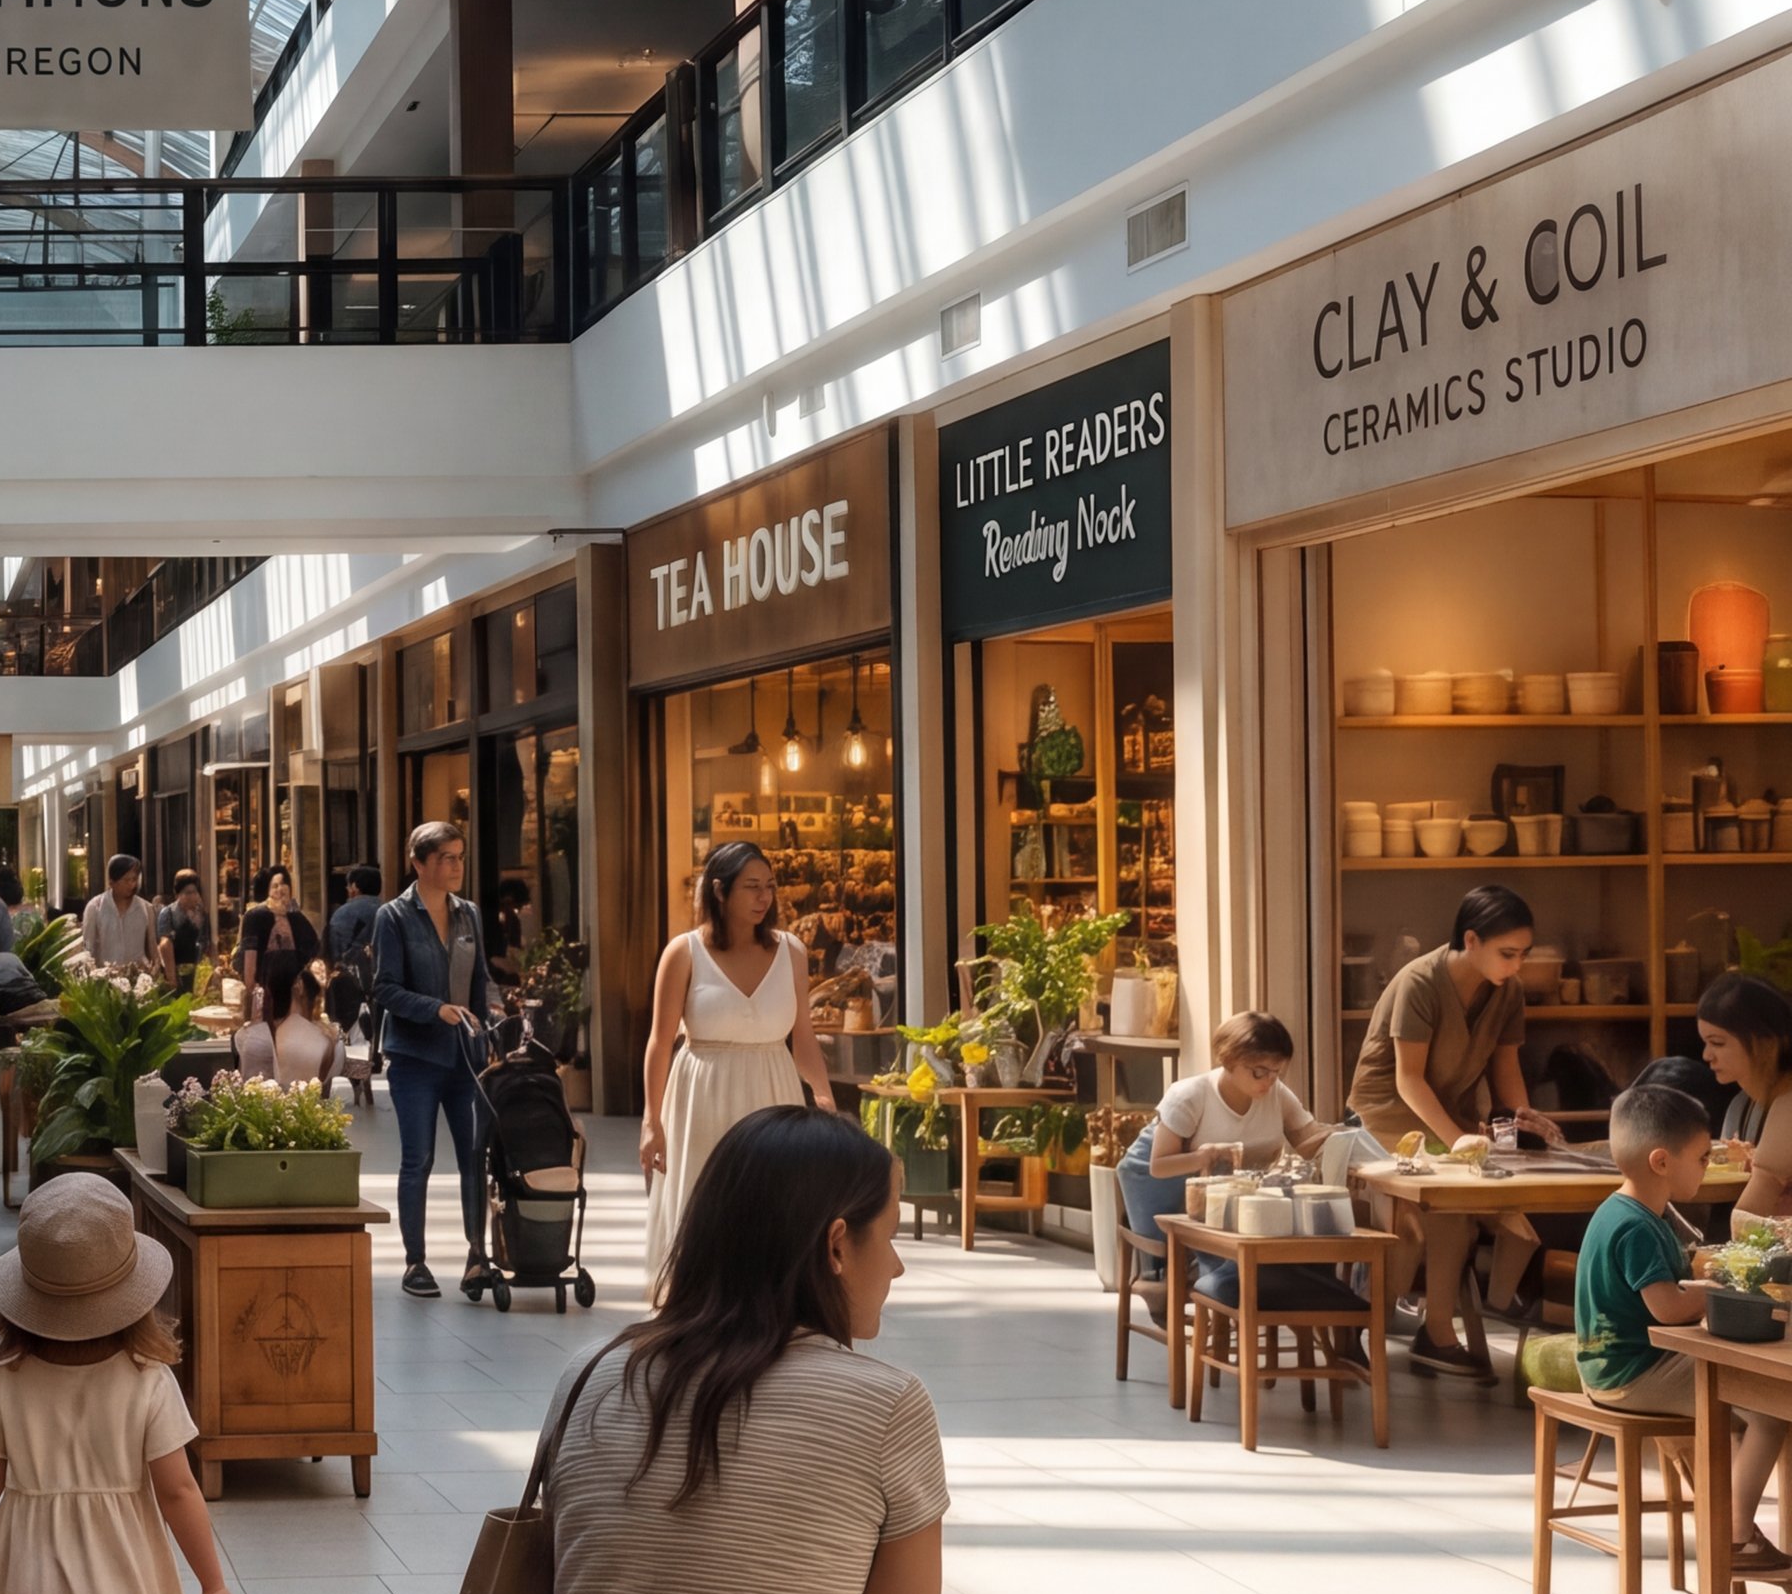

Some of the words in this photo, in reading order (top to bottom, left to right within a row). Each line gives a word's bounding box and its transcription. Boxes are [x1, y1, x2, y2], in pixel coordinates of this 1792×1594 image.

[1313, 262, 1440, 379] CLAY
[1461, 245, 1500, 331] &
[1524, 183, 1667, 305] COIL
[956, 437, 1034, 509] LITTLE
[1045, 392, 1166, 480] READERS
[1323, 369, 1486, 456] CERAMICS
[1505, 318, 1647, 403] STUDIO
[650, 551, 714, 632] TEA
[723, 499, 850, 611] HOUSE
[1076, 483, 1137, 551] Nock
